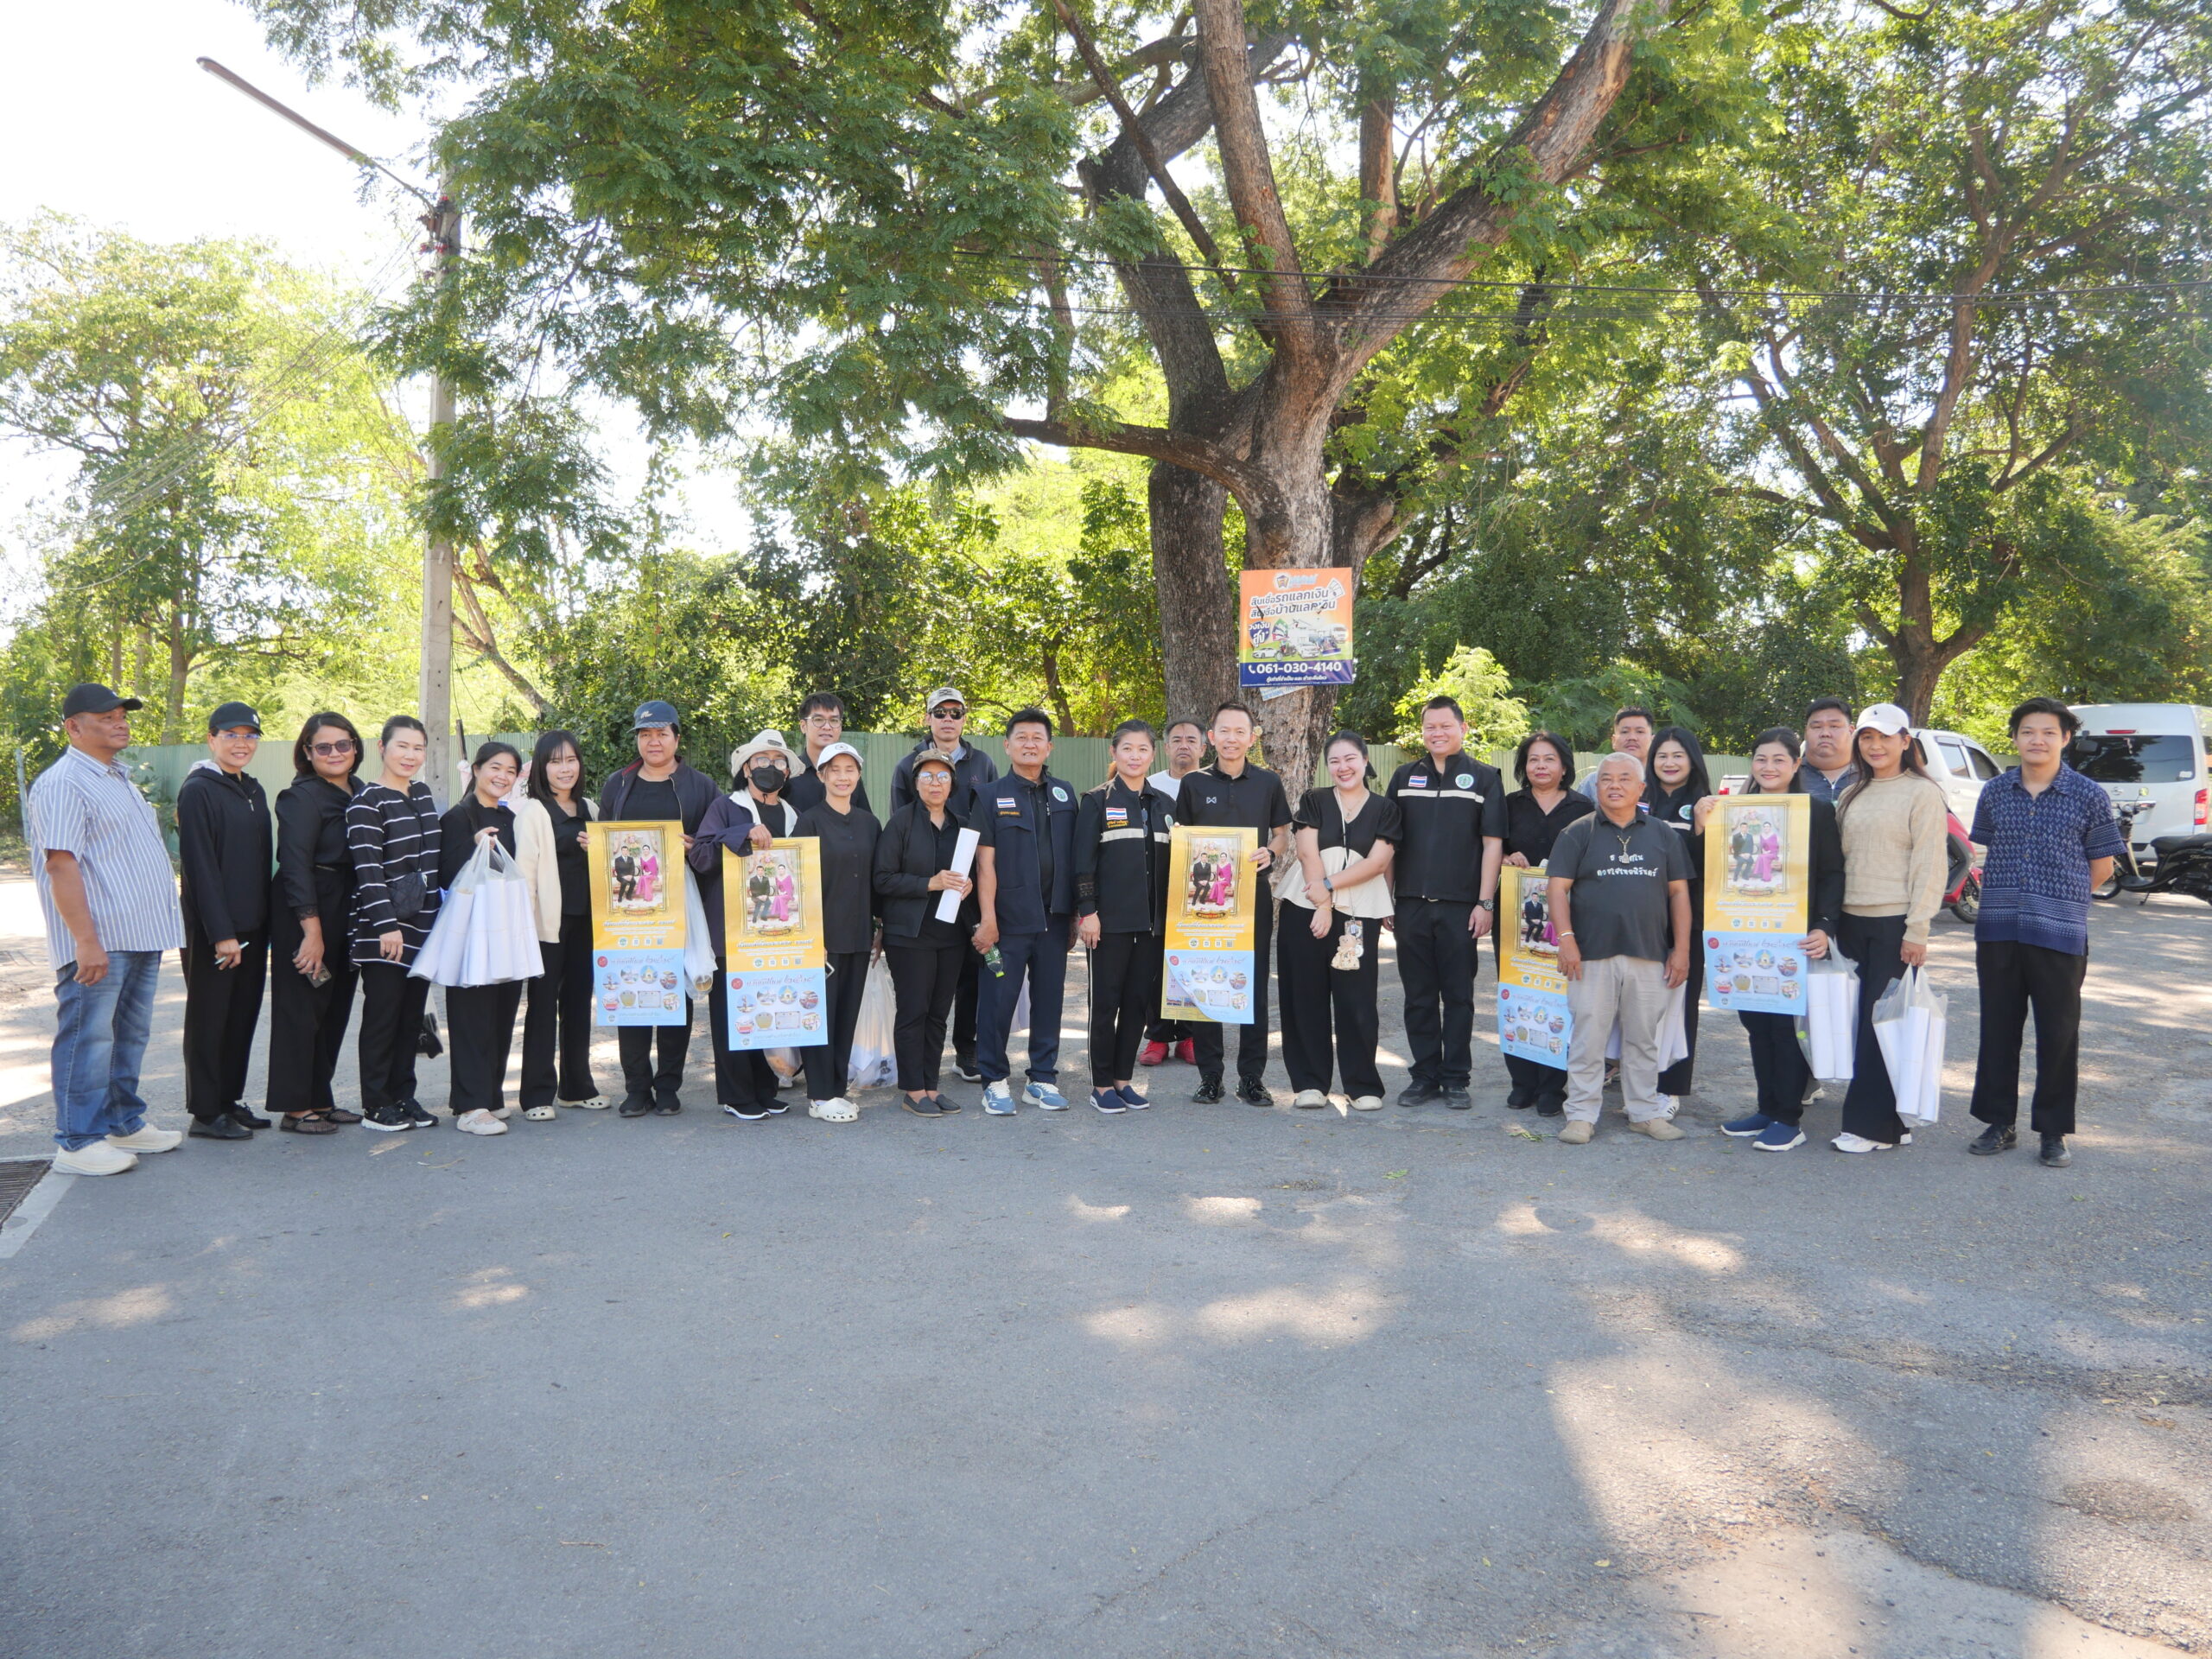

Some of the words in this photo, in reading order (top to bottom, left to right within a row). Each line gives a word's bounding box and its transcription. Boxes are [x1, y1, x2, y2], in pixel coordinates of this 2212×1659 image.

[1251, 588, 1328, 605] สินเชื่อรถแลกเงิน
[1251, 600, 1335, 617] สินชื่อบ้านแลกงิน
[1256, 662, 1342, 674] 061-030-4140
